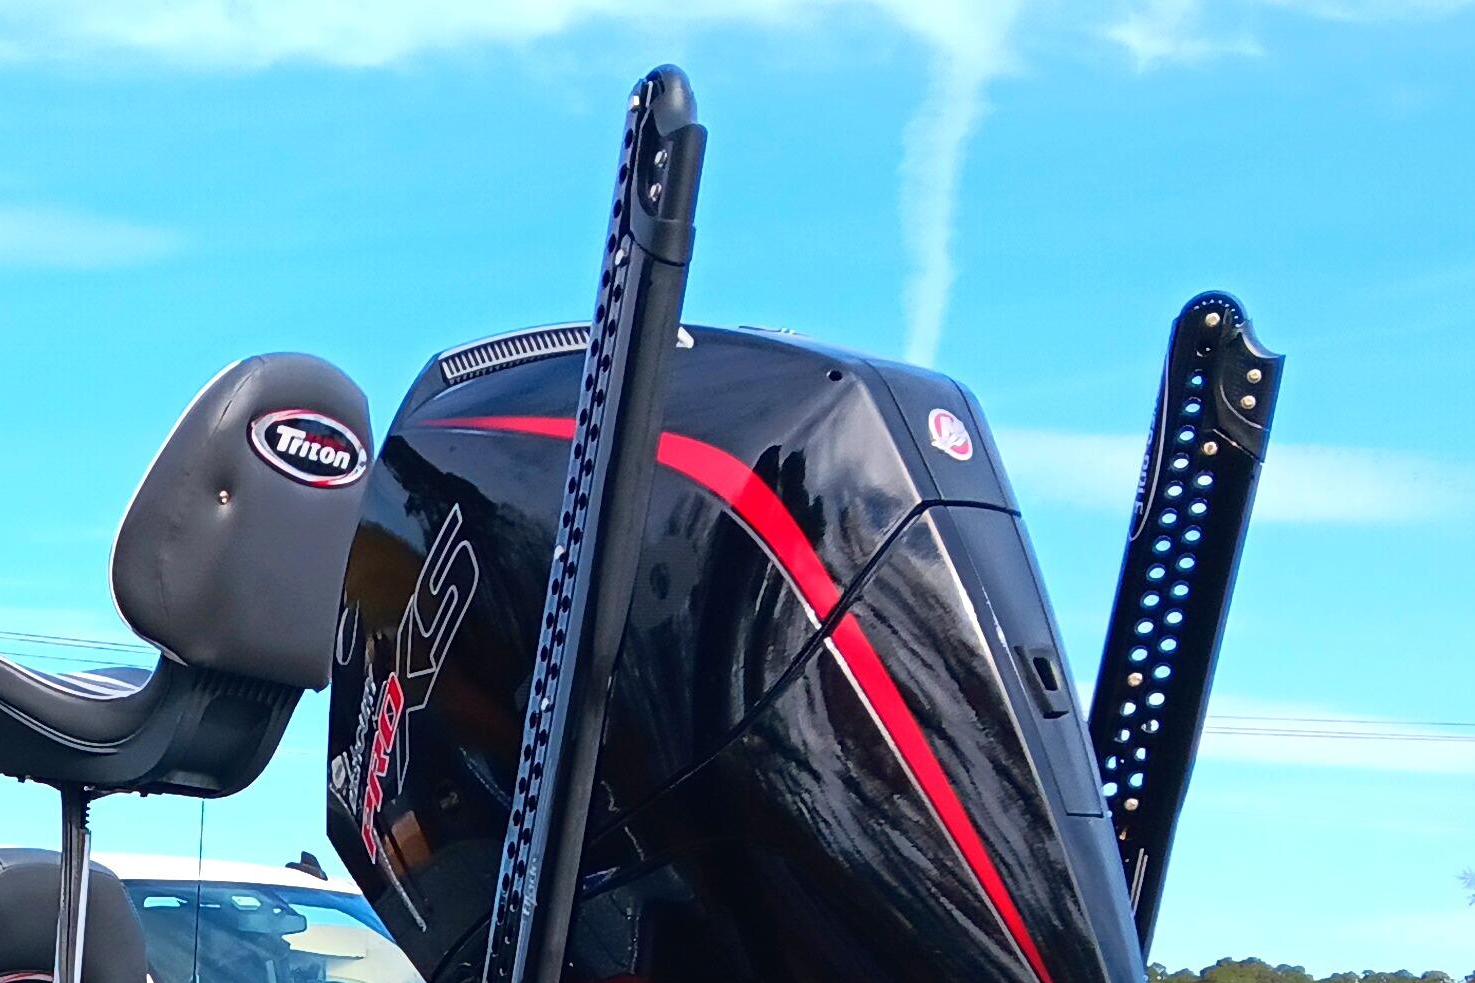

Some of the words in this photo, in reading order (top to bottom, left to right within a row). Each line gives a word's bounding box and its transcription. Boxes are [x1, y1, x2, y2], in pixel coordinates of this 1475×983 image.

[276, 424, 351, 470] Triton
[361, 672, 404, 864] PRO
[396, 503, 479, 796] XS
